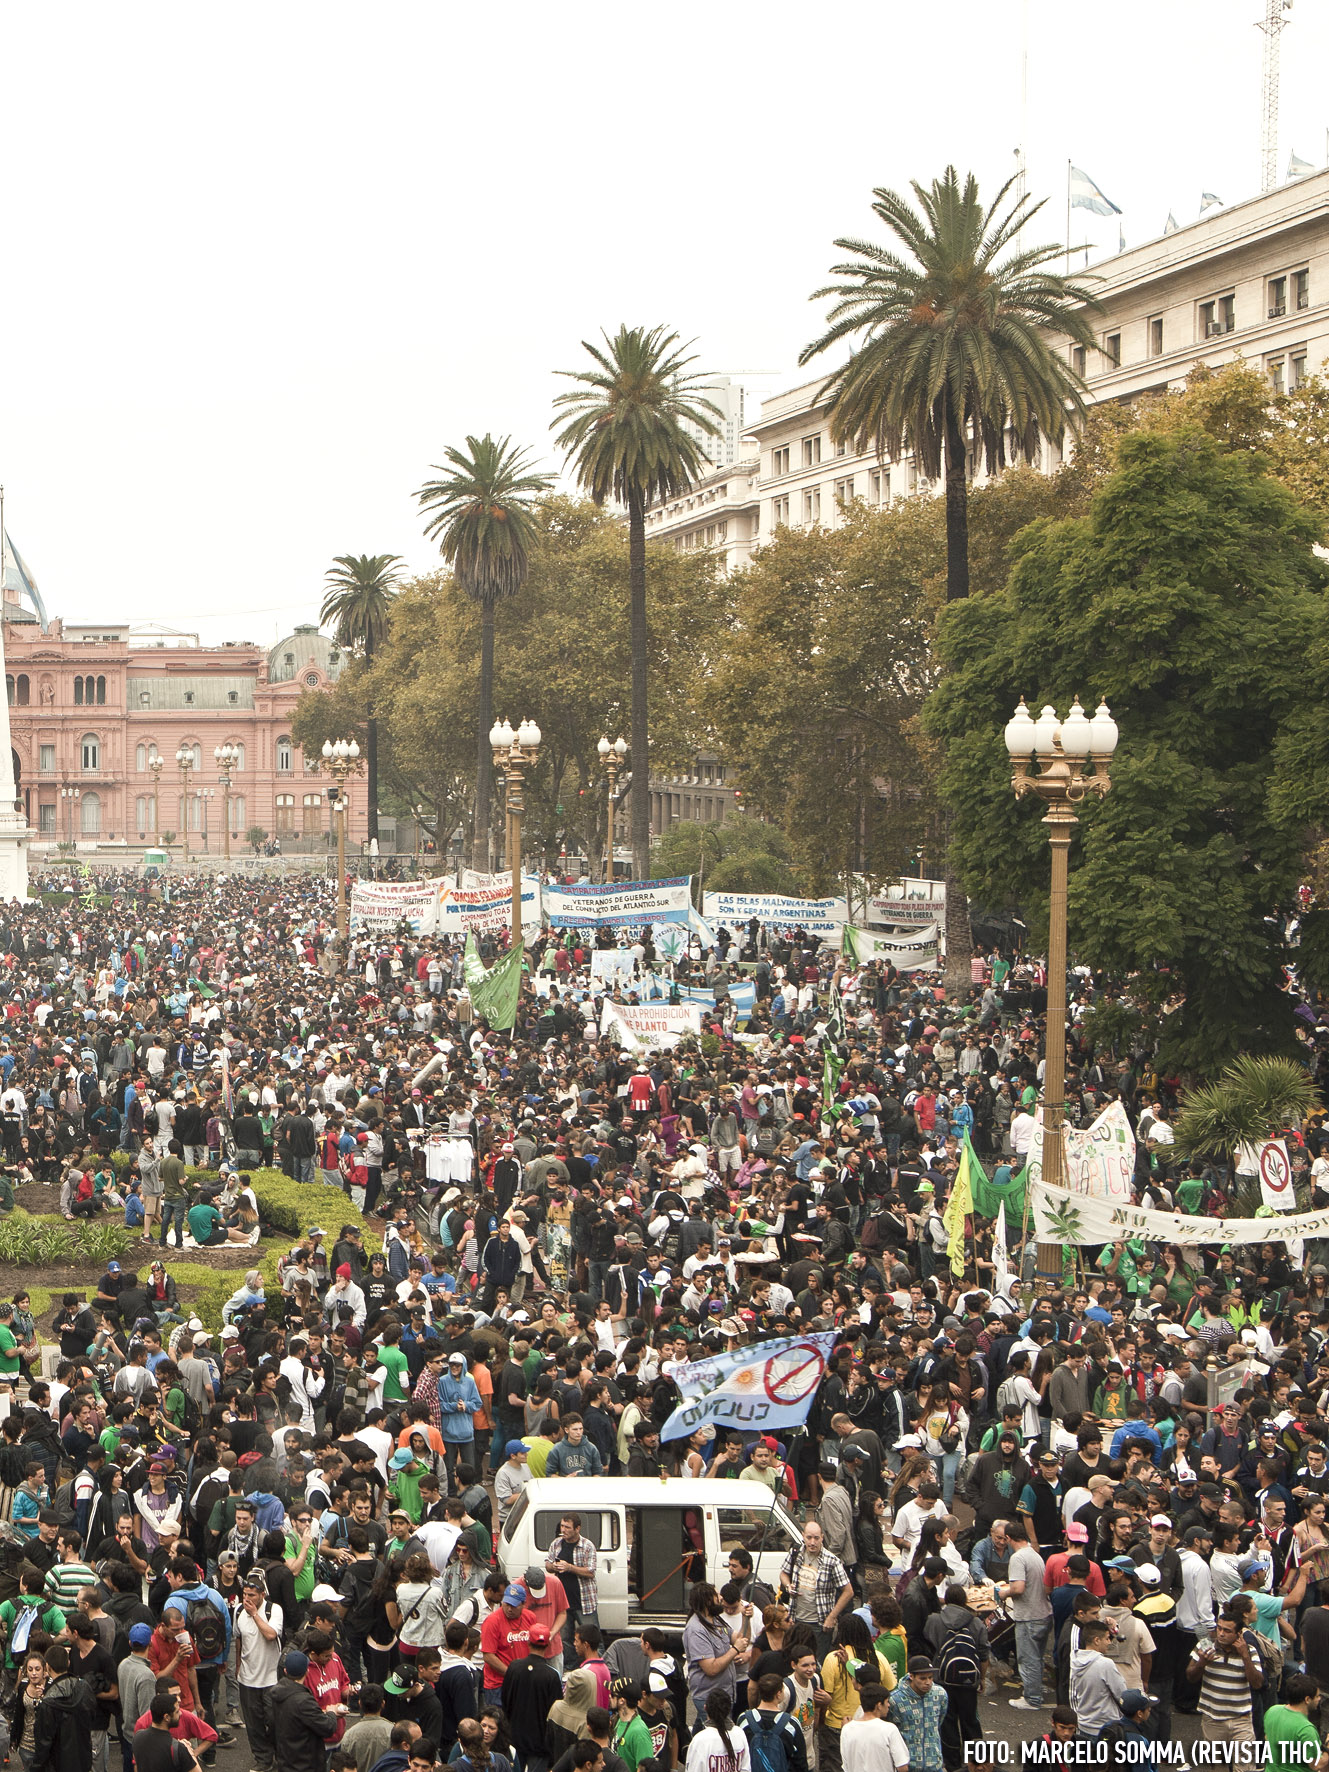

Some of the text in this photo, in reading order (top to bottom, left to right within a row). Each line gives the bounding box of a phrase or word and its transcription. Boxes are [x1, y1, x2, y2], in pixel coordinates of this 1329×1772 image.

[561, 885, 615, 895] CAMPAMENTO
[635, 881, 656, 890] PLAZA
[572, 895, 613, 906] VETERANOS
[624, 893, 655, 902] GUERRA
[718, 896, 734, 904] LAS
[737, 897, 759, 905] ISLAS
[762, 898, 805, 907] MALVINAS
[576, 905, 609, 913] CONFLICTO
[623, 901, 656, 910] ATLANTICO
[657, 898, 669, 906] SUR
[912, 903, 925, 911] PLAZA
[932, 903, 944, 911] MAYO
[378, 907, 402, 916] NUESTRA
[405, 907, 424, 917] LUCHA
[719, 905, 735, 913] SON
[773, 909, 826, 918] ARGENTINAS
[880, 909, 905, 918] VETERANOS
[913, 911, 934, 919] GUERRA
[482, 920, 490, 928] DE
[492, 917, 507, 926] MAYO
[602, 917, 627, 925] AHORA
[633, 915, 667, 923] SIEMPRE
[874, 940, 937, 952] KRYPTONITE
[628, 1008, 638, 1018] LA
[639, 1007, 690, 1019] PROHIBICIÓN
[636, 1021, 668, 1031] PLANTO
[566, 1455, 586, 1469] GAP
